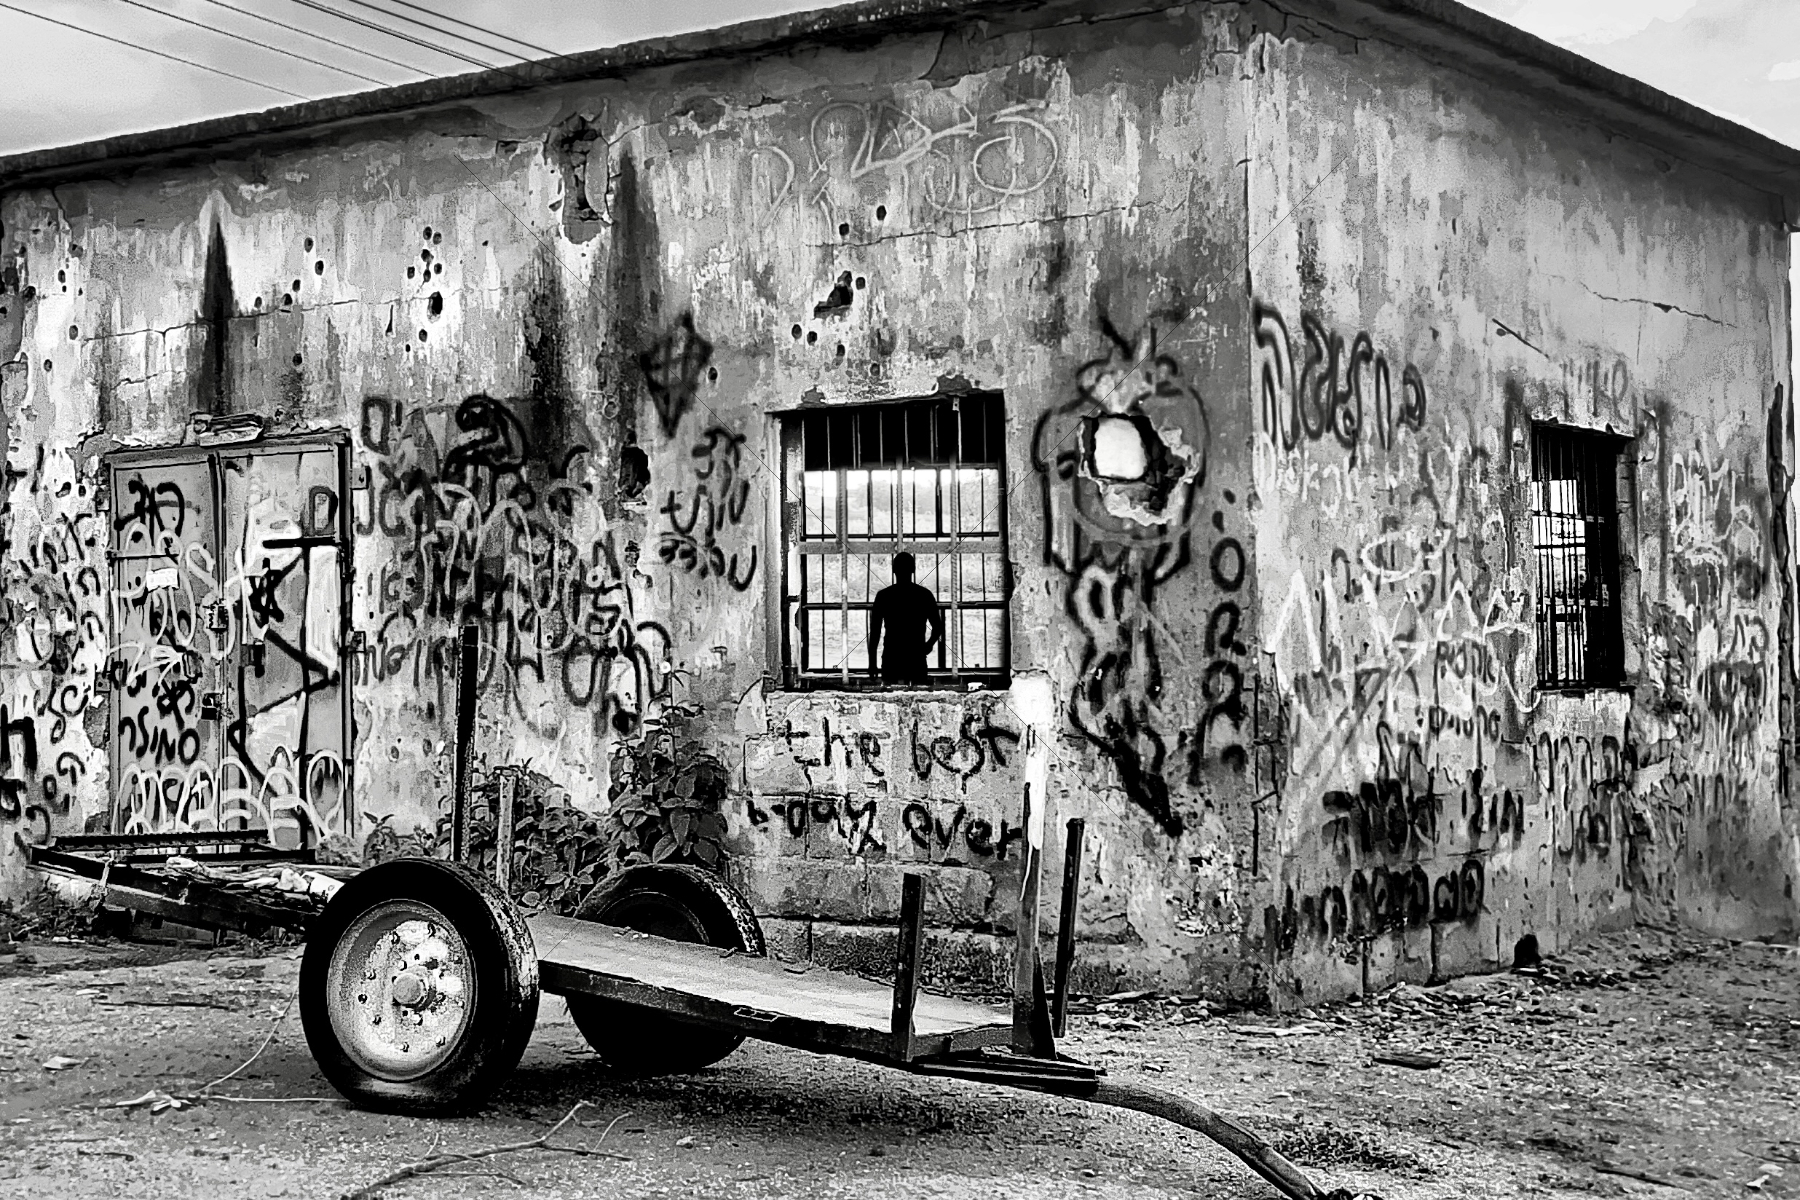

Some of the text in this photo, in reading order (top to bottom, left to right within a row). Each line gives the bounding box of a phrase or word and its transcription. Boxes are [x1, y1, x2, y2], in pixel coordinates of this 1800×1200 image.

[776, 710, 1021, 790] the best
[902, 801, 1023, 861] ever
